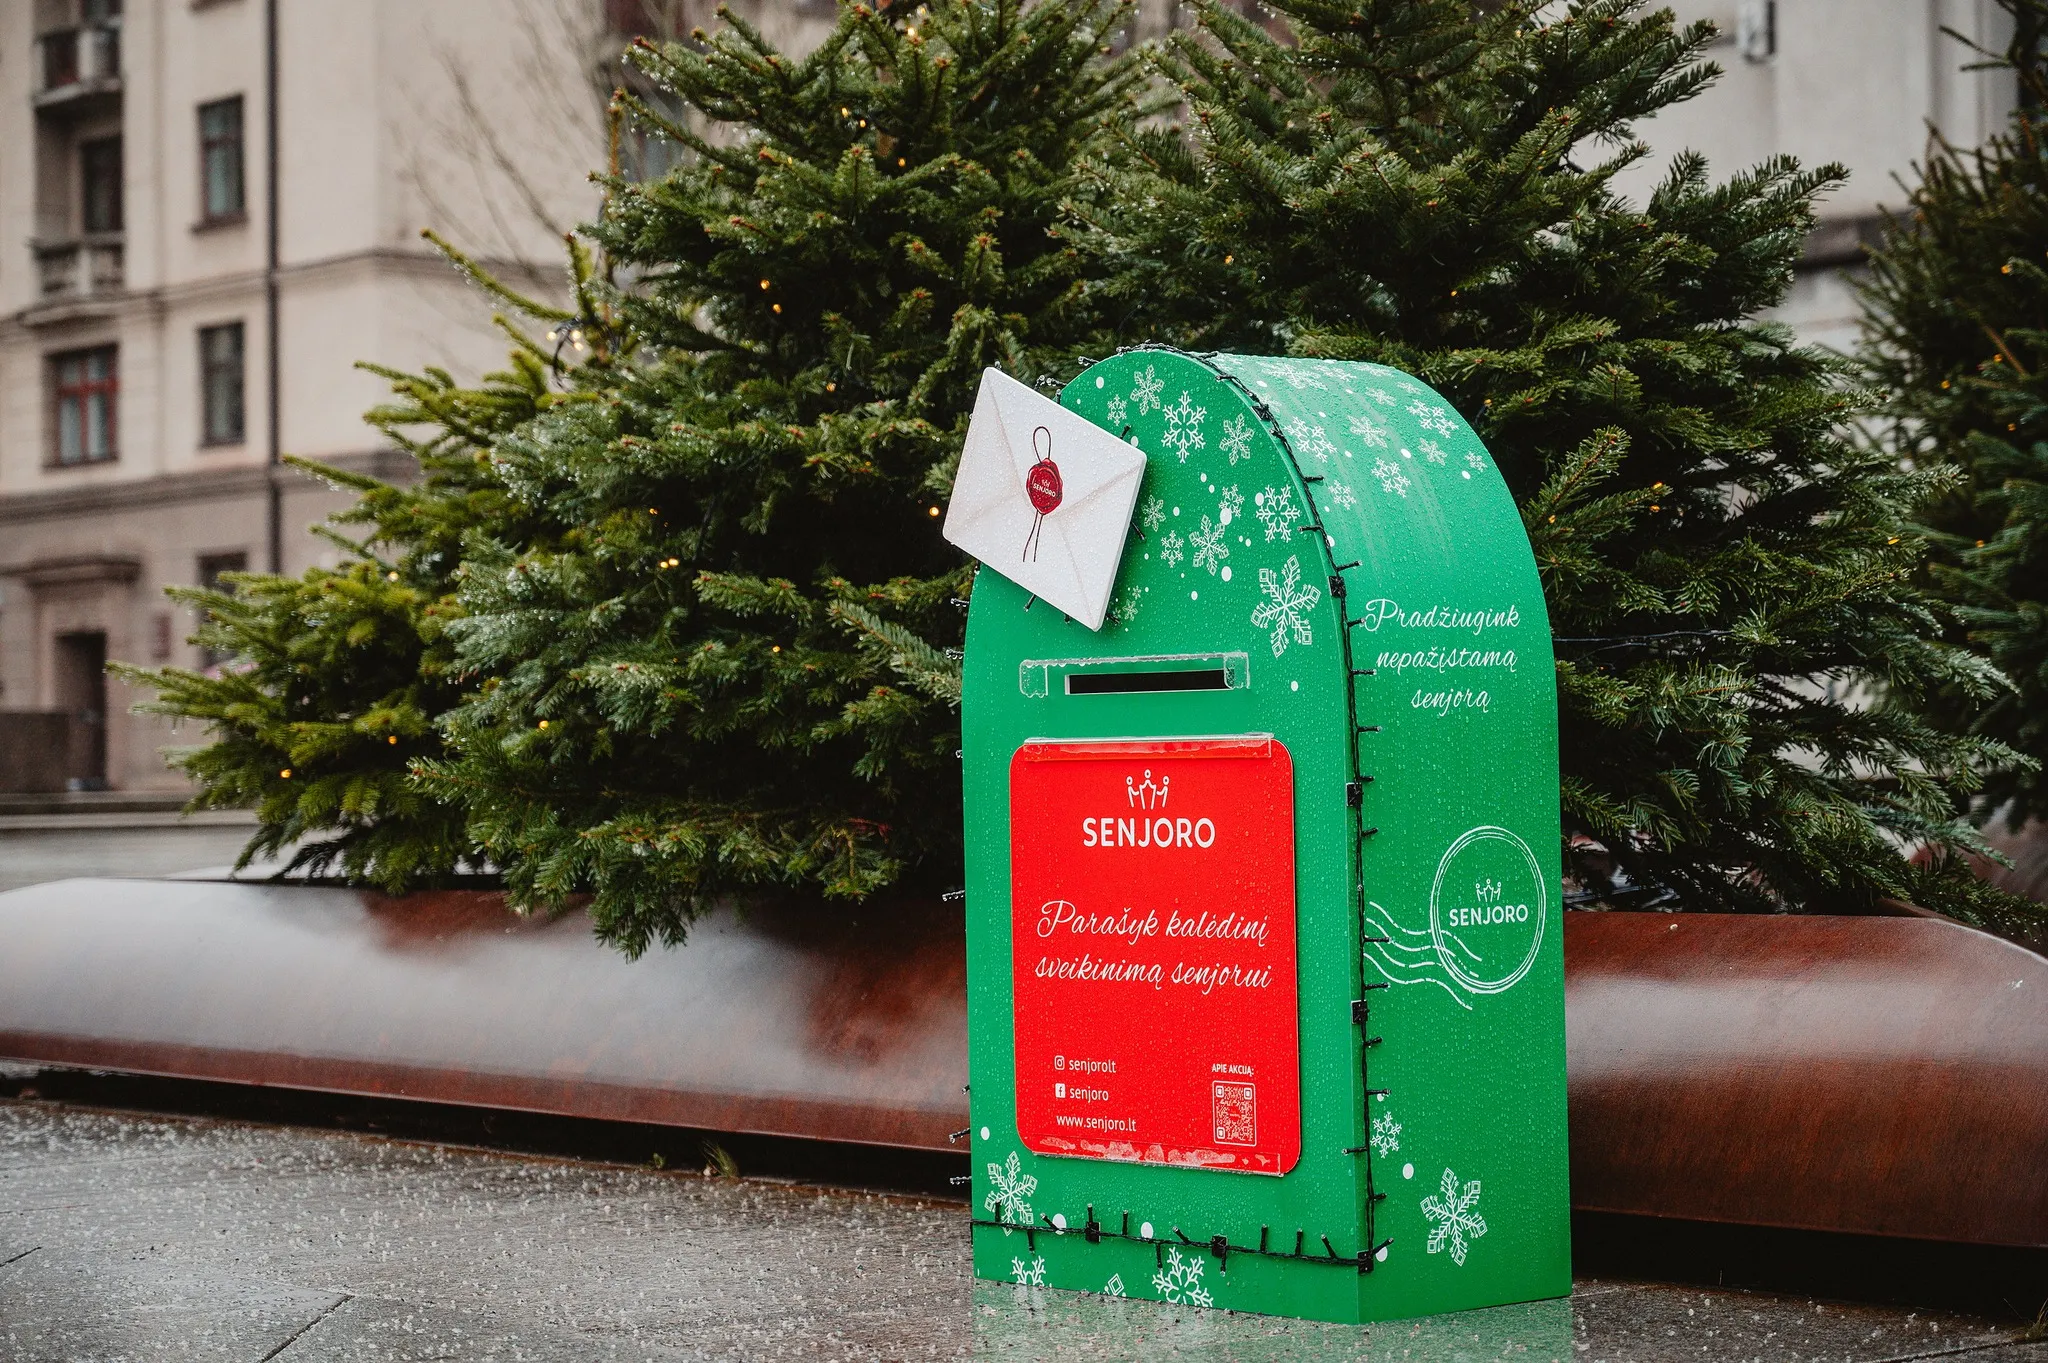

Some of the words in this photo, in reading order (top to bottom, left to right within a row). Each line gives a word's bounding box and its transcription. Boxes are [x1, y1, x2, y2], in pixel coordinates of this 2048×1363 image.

[1033, 483, 1056, 497] SENJORO
[1364, 598, 1520, 635] Pradžiugink
[1376, 646, 1518, 675] nepažįstamą
[1411, 688, 1491, 717] senjorą
[1082, 817, 1216, 848] SENJORO
[1037, 900, 1159, 945] Parašyk
[1166, 910, 1269, 947] kalėdinį
[1449, 904, 1528, 927] SENJORO
[1035, 953, 1165, 990] sveikinimą
[1171, 962, 1272, 995] senjorui
[1068, 1058, 1117, 1074] senjorolt
[1212, 1063, 1227, 1073] APIE
[1069, 1085, 1109, 1102] senjoro
[1056, 1115, 1137, 1132] www.senjoro.lt
